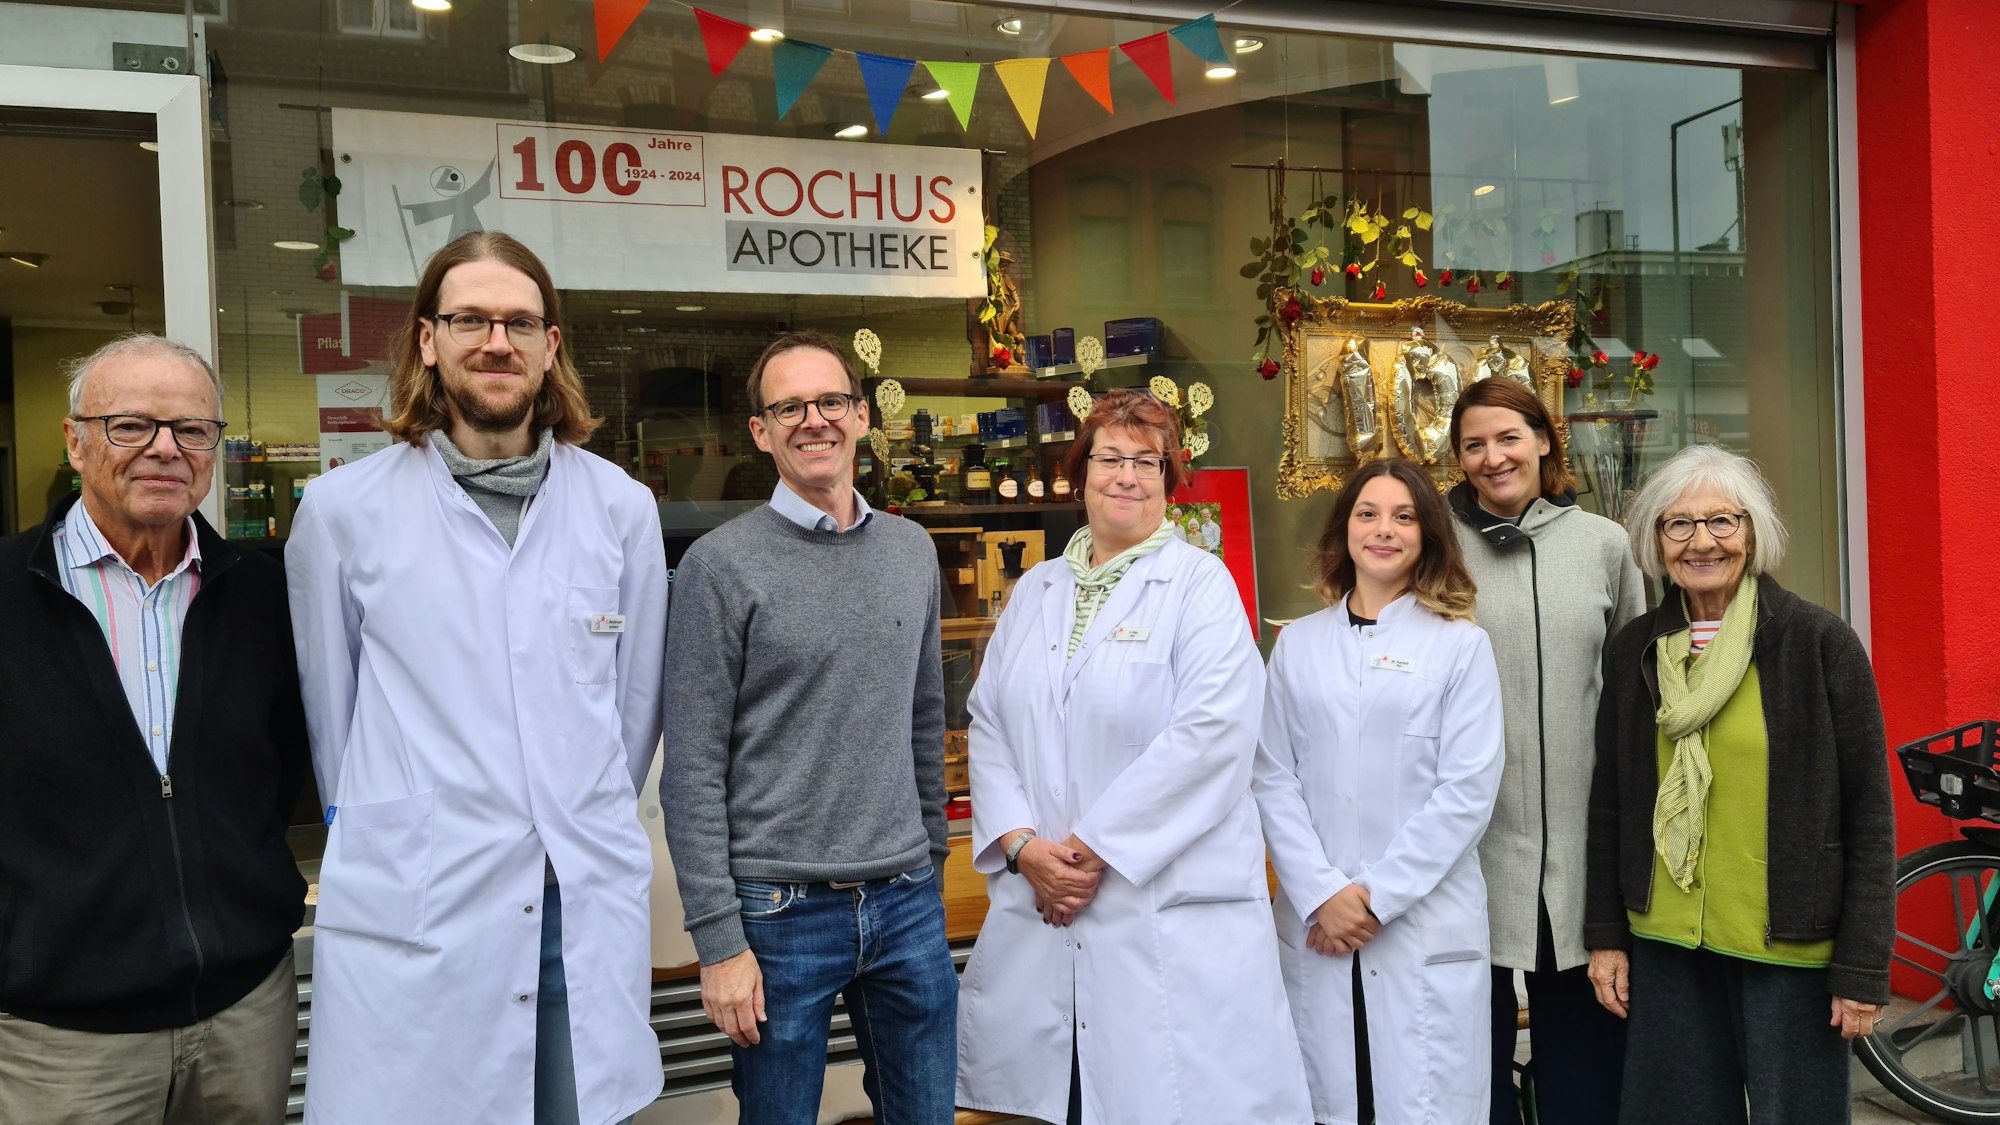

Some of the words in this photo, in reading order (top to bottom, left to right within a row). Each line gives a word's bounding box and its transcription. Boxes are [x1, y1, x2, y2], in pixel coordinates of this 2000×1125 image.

[647, 137, 692, 151] Jahre
[624, 168, 657, 180] 1924
[668, 170, 701, 182] 2024
[721, 165, 956, 224] ROCHUS
[732, 226, 949, 270] APOTHEKE
